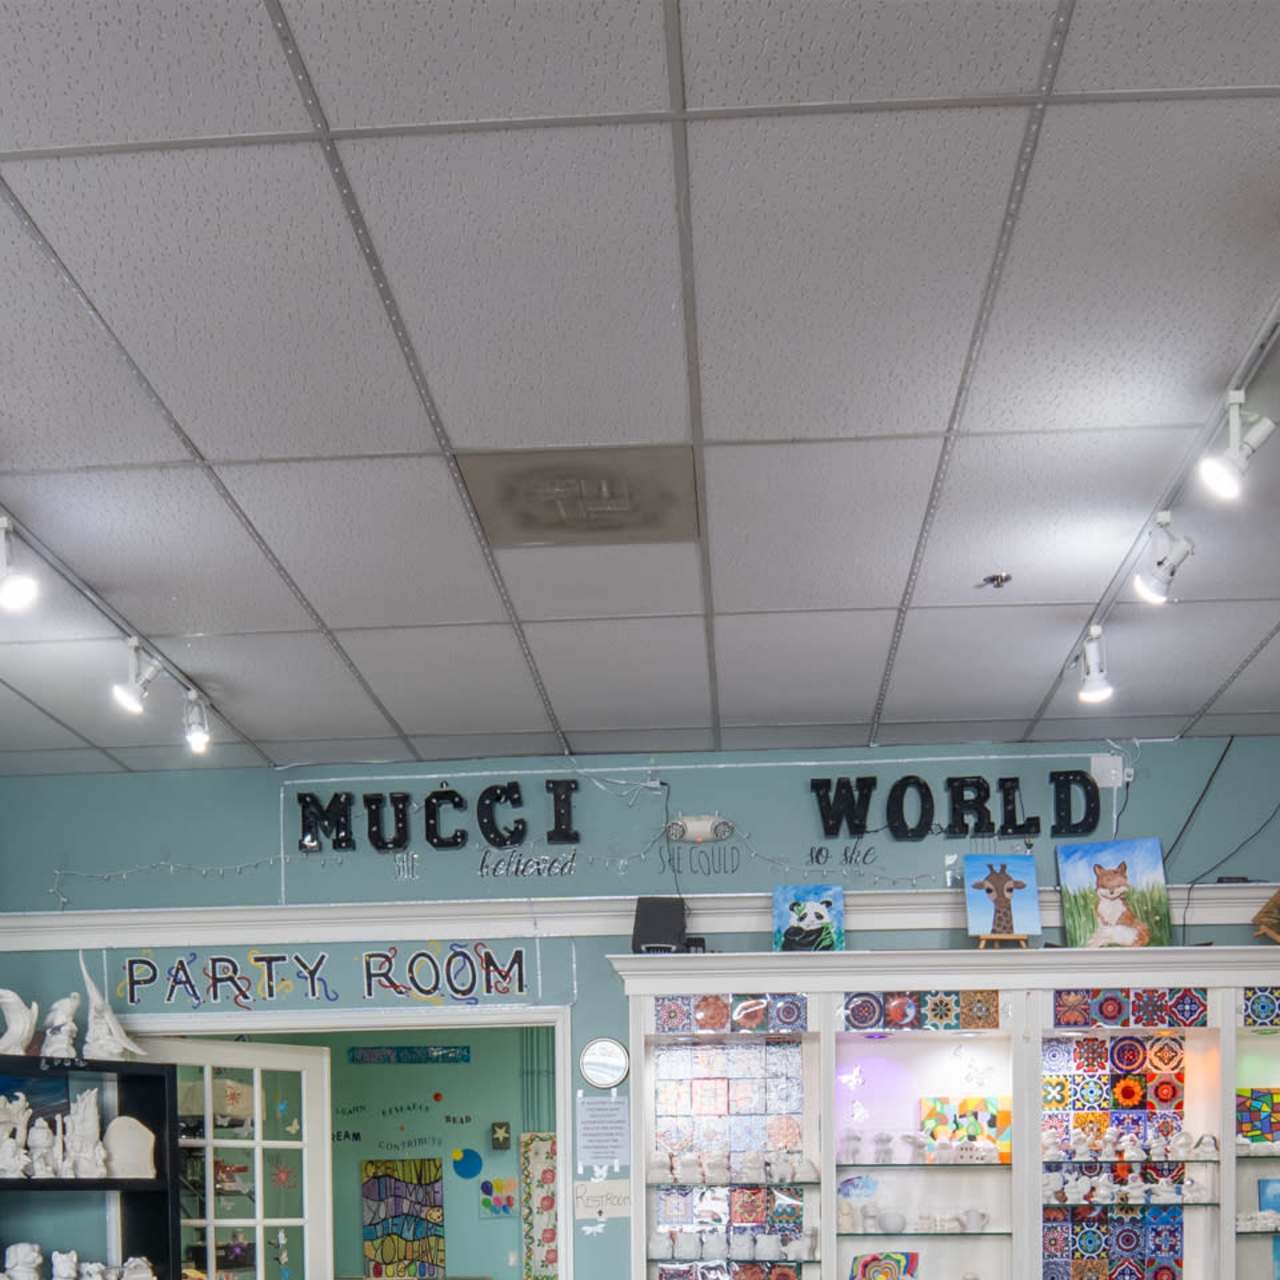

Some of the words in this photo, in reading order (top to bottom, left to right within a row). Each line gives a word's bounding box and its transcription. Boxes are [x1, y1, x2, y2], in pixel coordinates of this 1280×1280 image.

[297, 779, 580, 852] MUCCI
[810, 769, 1101, 841] WORLD
[477, 849, 577, 878] believed
[689, 846, 740, 875] COULD
[806, 846, 833, 866] so
[840, 840, 878, 865] she
[126, 950, 329, 1005] PARTY
[362, 946, 528, 1000] ROOM
